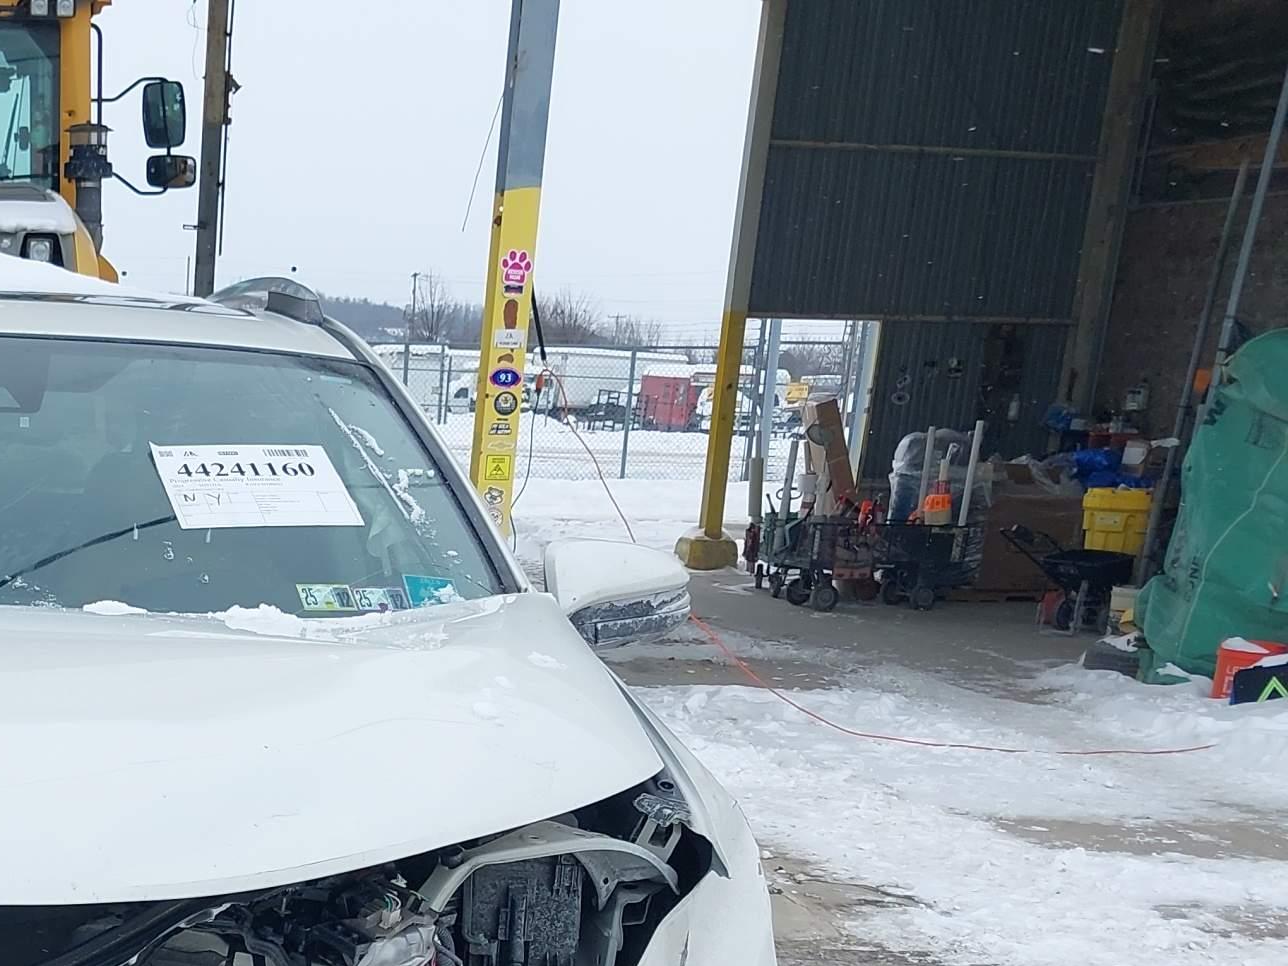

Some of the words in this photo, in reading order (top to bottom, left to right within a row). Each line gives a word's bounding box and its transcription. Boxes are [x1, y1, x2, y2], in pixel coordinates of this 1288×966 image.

[499, 373, 512, 383] 93
[177, 462, 315, 477] 44241160
[301, 588, 318, 605] 25
[336, 591, 351, 608] 12
[355, 590, 372, 607] 25
